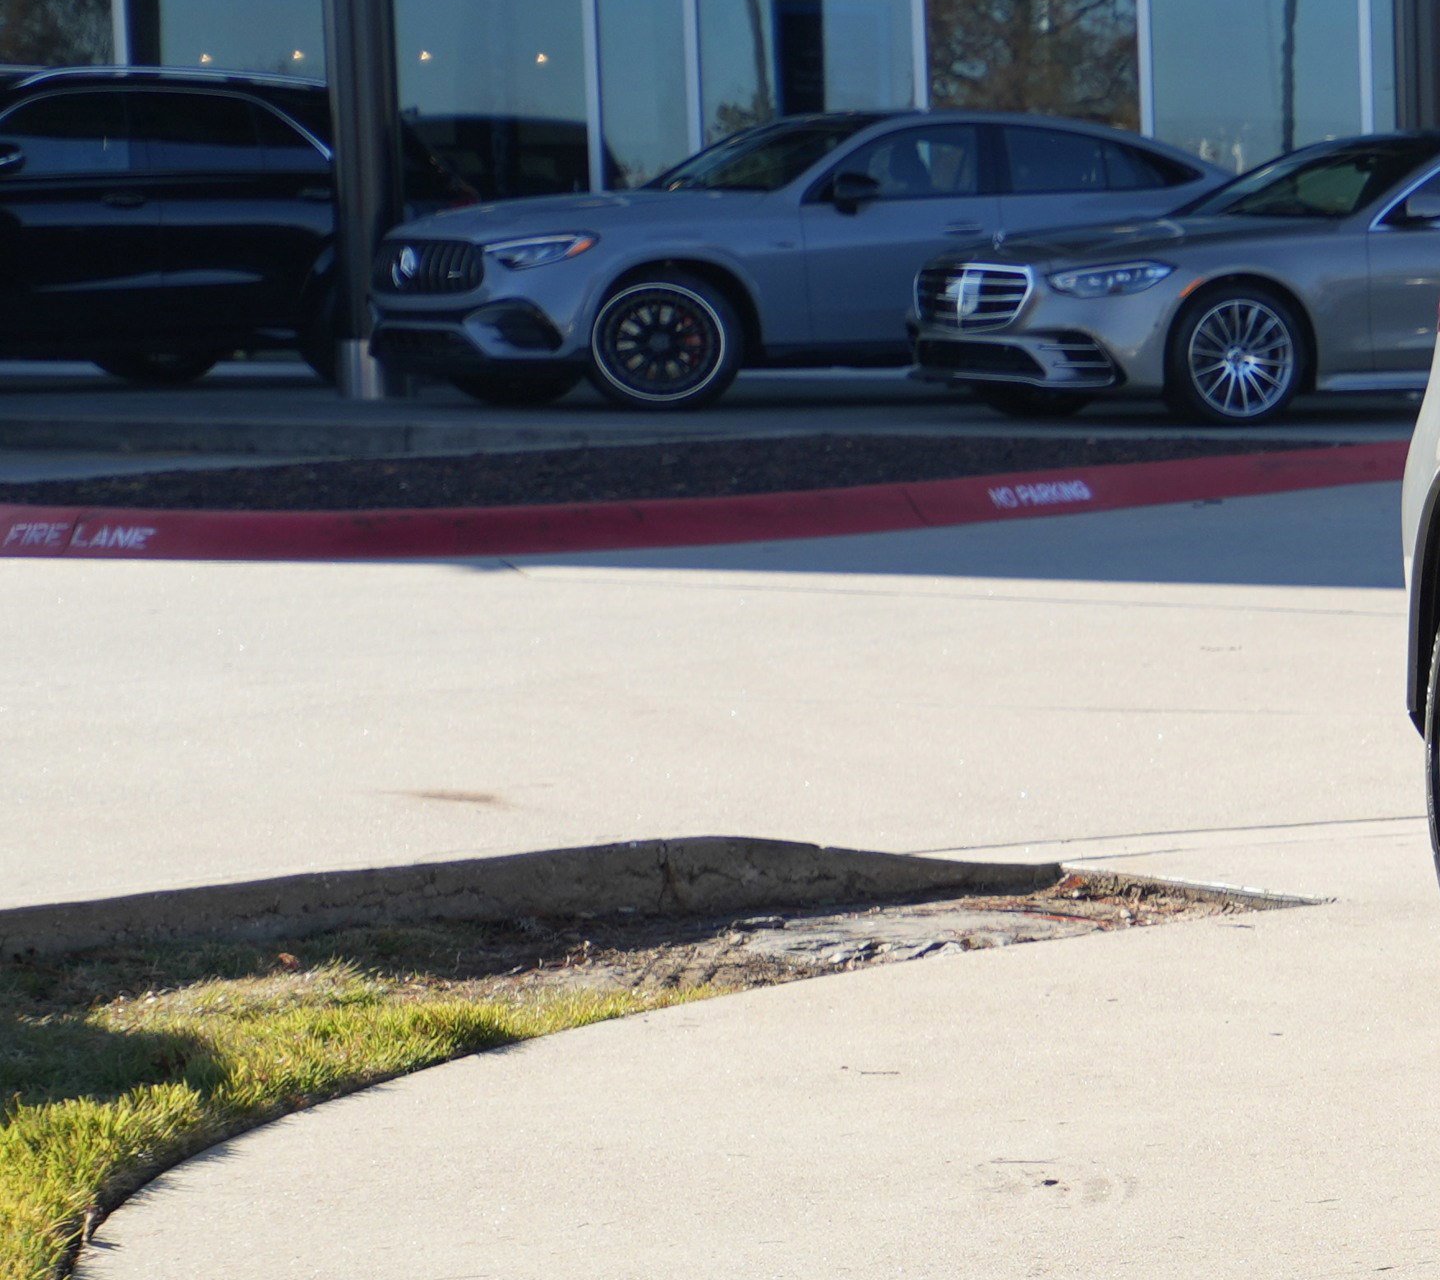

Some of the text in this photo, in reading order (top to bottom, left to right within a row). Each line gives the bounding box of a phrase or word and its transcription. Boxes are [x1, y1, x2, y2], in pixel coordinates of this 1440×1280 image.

[985, 485, 1019, 510] NO
[3, 521, 157, 550] FIRE LANE
